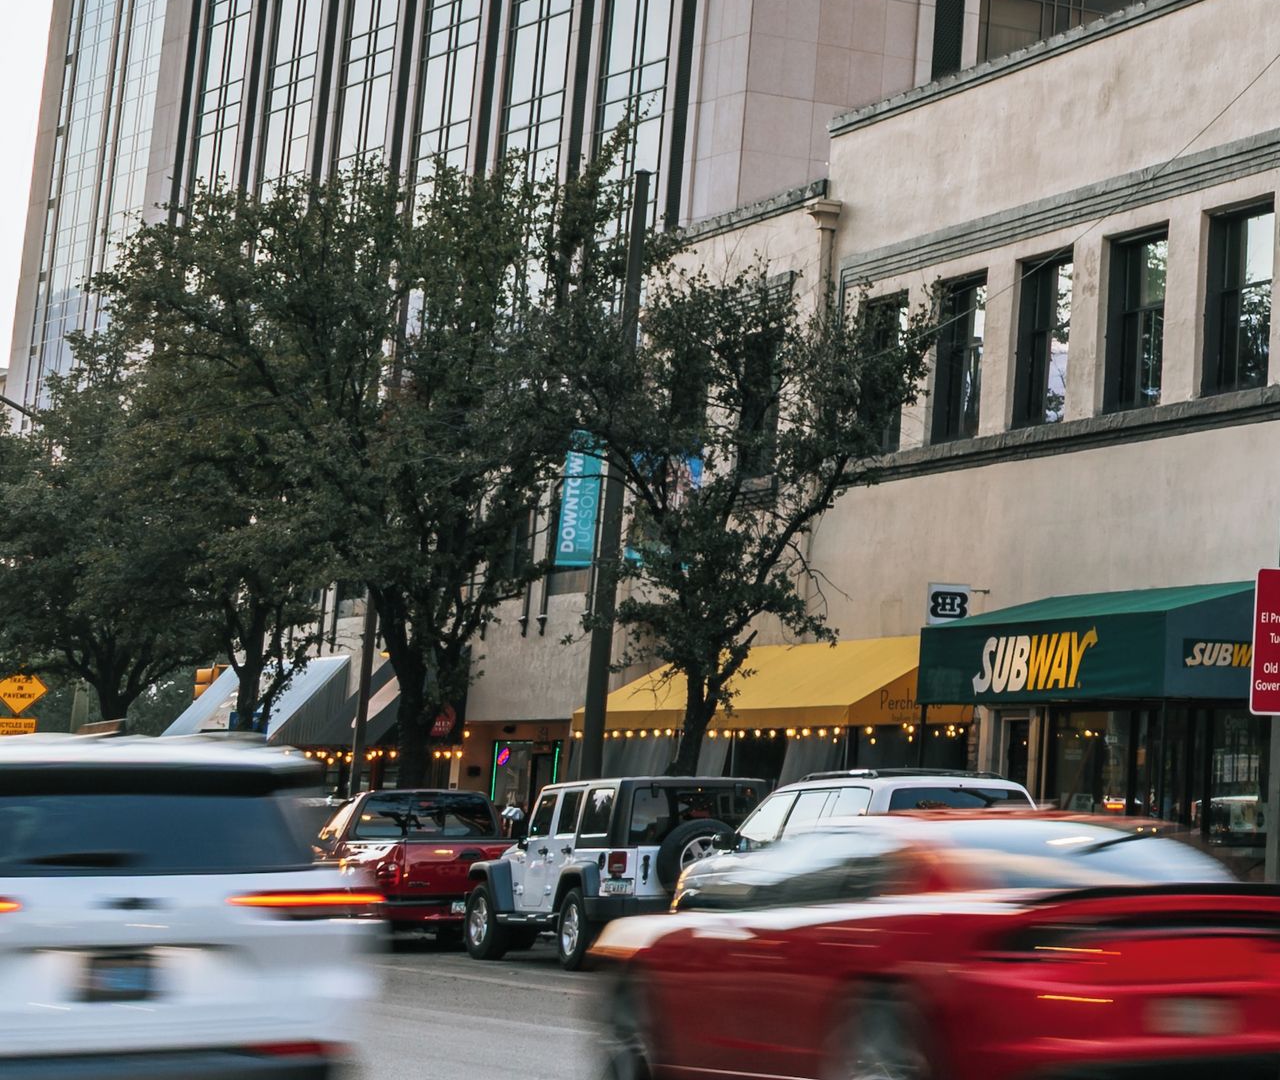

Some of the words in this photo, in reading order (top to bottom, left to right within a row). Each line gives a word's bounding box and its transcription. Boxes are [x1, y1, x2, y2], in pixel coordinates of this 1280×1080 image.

[560, 452, 584, 552] DOWNTOW
[576, 483, 595, 551] TUCSON
[1261, 612, 1269, 623] El
[972, 625, 1098, 696] SUBWAY
[1185, 641, 1252, 668] SUBW
[1264, 663, 1278, 674] Old
